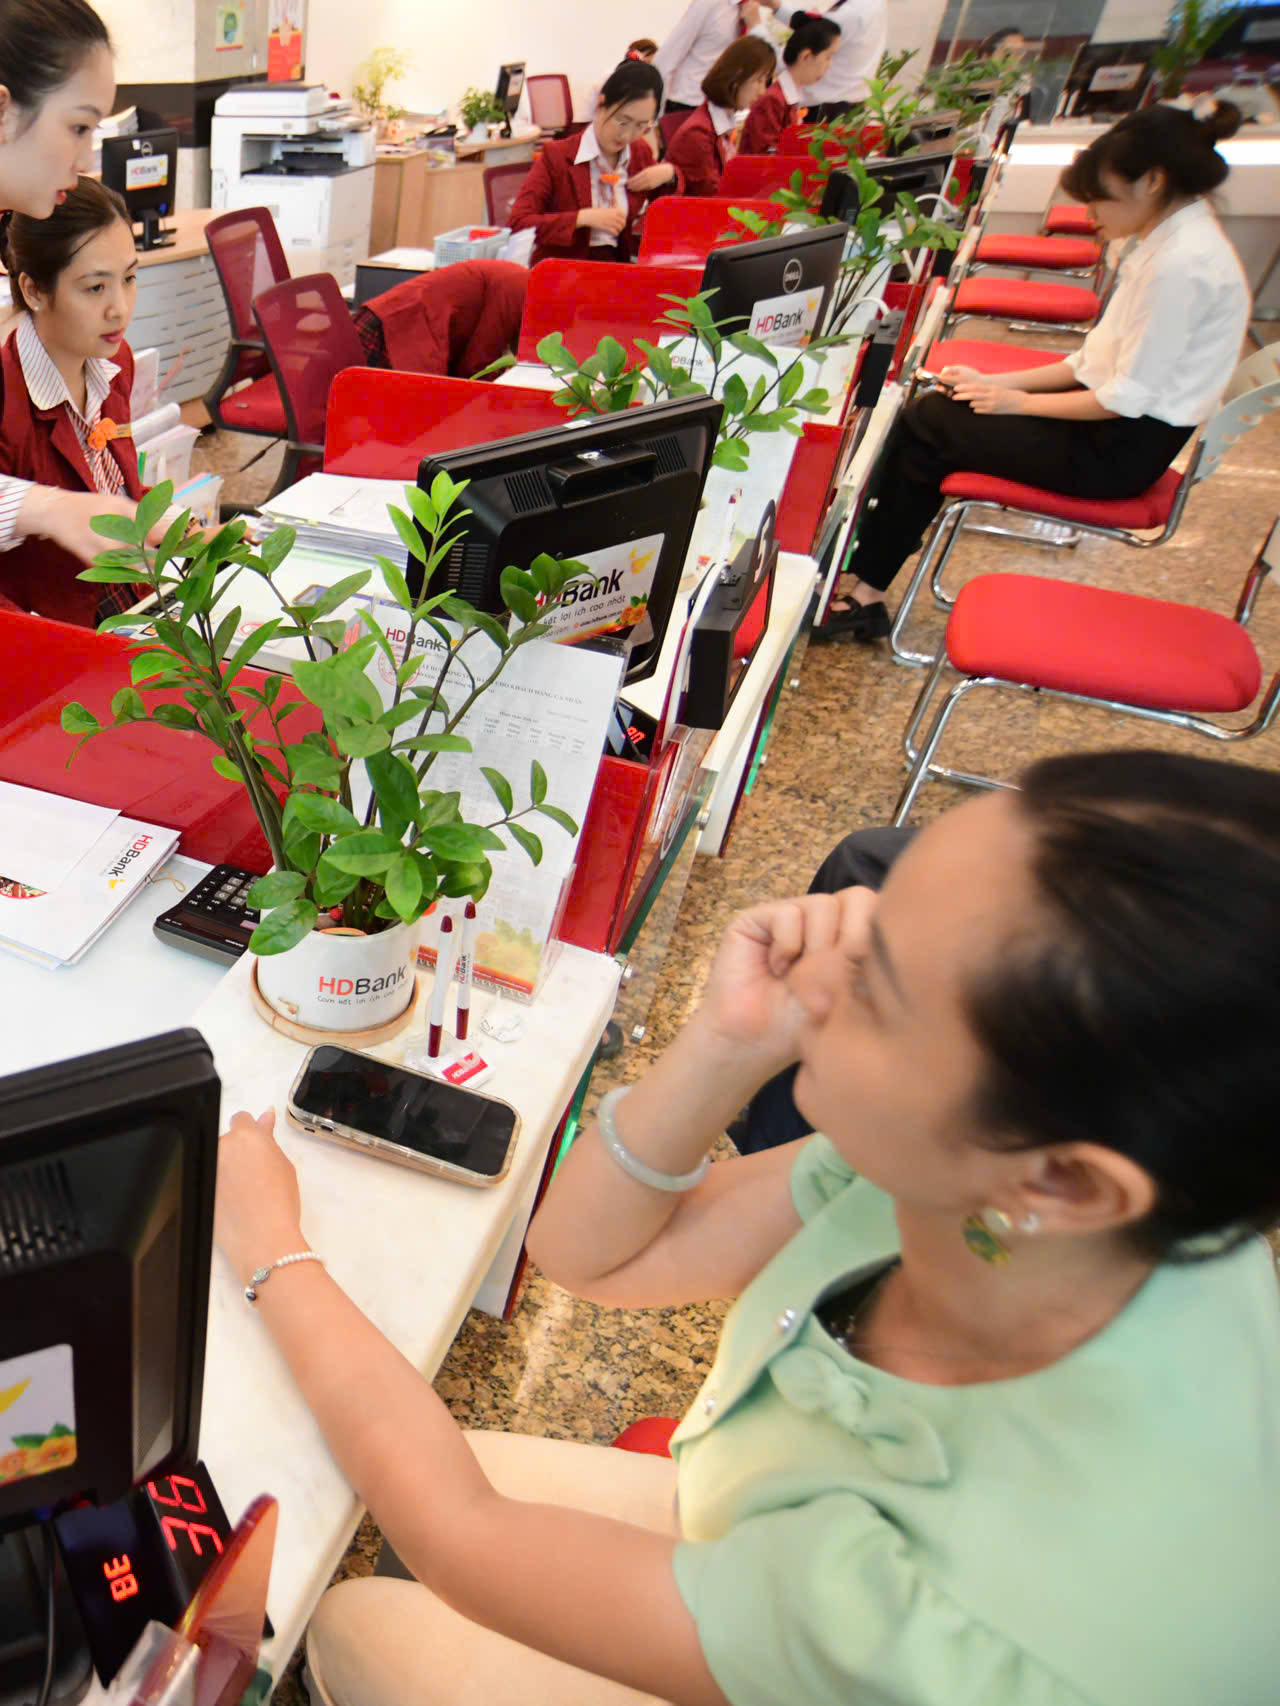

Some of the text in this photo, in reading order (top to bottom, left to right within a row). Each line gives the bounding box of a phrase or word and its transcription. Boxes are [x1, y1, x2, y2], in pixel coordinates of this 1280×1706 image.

[754, 308, 805, 336] HDBank
[385, 627, 442, 651] HDank
[108, 834, 154, 877] HDBank
[319, 964, 407, 996] HDBank
